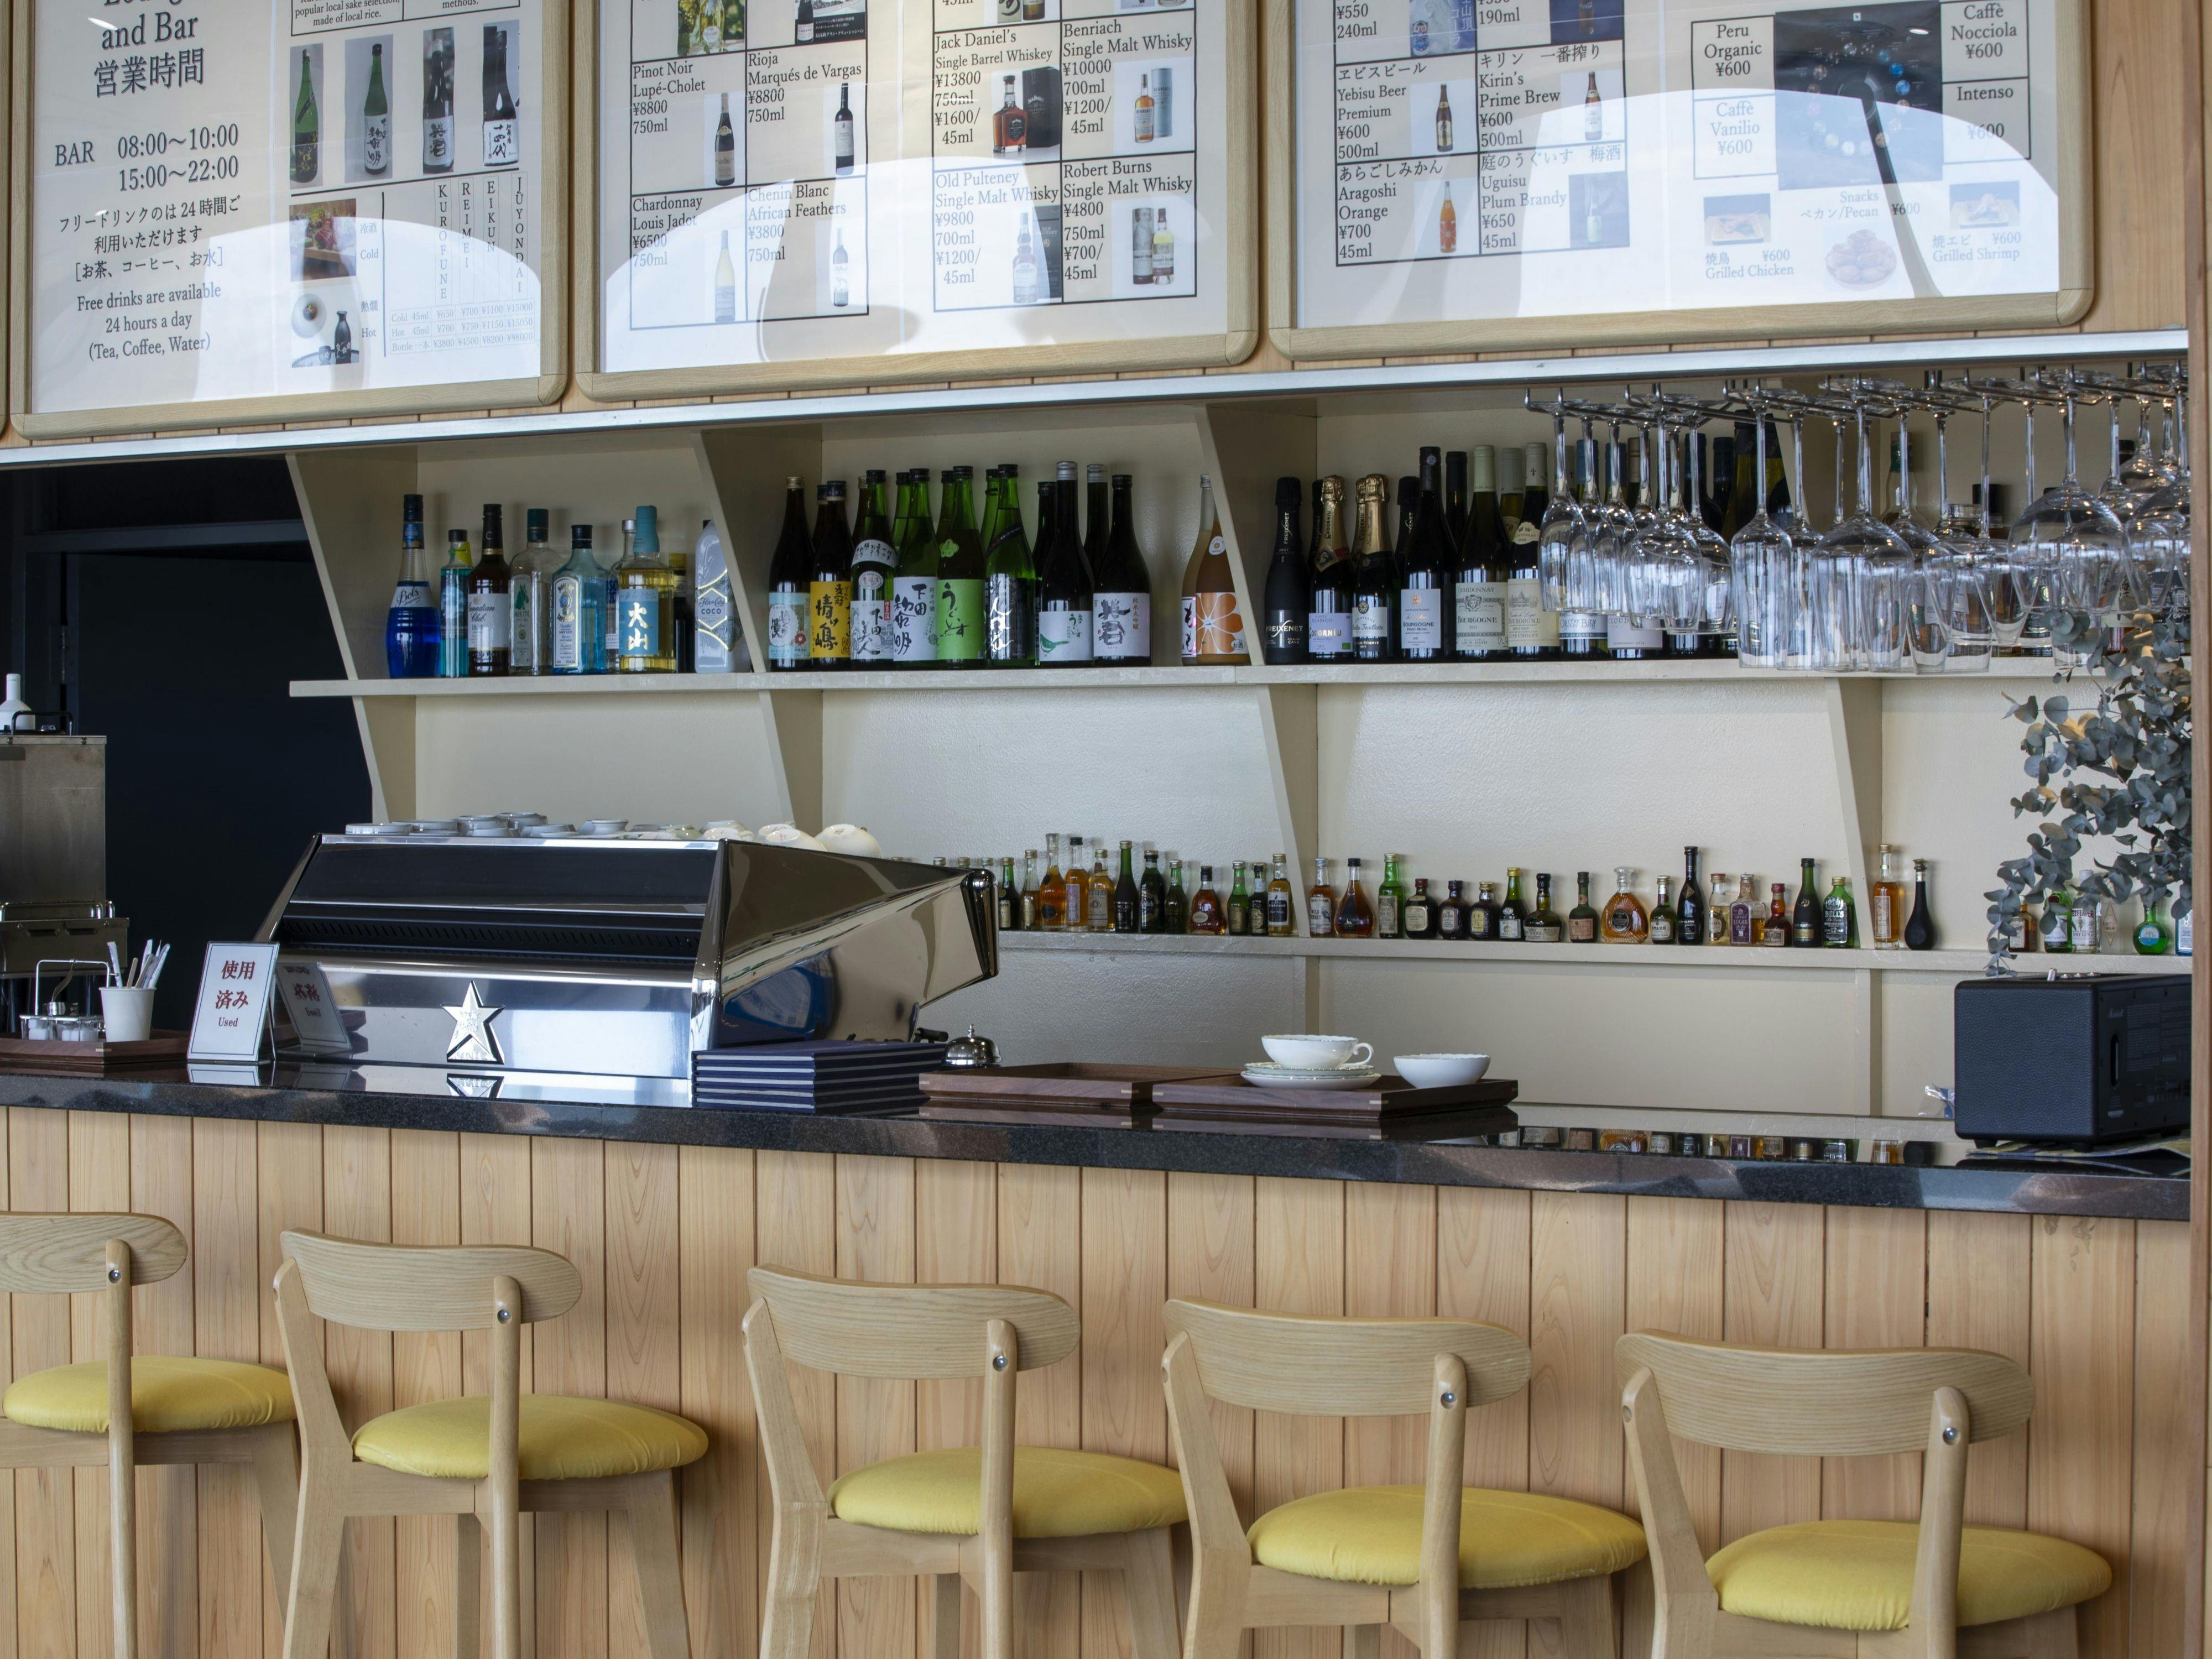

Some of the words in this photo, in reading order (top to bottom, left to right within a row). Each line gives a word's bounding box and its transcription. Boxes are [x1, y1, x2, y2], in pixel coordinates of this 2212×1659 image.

[295, 6, 324, 18] popular
[326, 2, 344, 12] local
[312, 15, 333, 26] made
[335, 13, 343, 23] of
[345, 11, 363, 22] local
[365, 10, 382, 19] rice.
[1336, 5, 1369, 19] ¥550
[1479, 8, 1520, 25] 190ml
[1963, 3, 2005, 20] Caffè
[102, 14, 146, 50] and
[155, 11, 199, 43] Bar
[1063, 20, 1122, 38] Benriach
[1337, 22, 1378, 38] 240ml
[1716, 24, 1749, 39] Peru
[1950, 23, 2017, 41] Nocciola
[935, 34, 961, 54] Jack
[1063, 40, 1103, 59] Single
[1107, 37, 1139, 54] Malt
[1141, 34, 1192, 52] Whisky
[1704, 42, 1762, 60] Organic
[1965, 43, 2003, 59] ¥600
[748, 53, 779, 67] Rioja
[936, 55, 968, 71] Single
[971, 51, 1003, 66] Barrel
[1007, 48, 1053, 65] Whiskey
[1480, 53, 1524, 69] キリン
[1540, 44, 1600, 64] 一番搾り
[93, 48, 205, 98] 営業時間
[633, 65, 664, 79] Pinot
[667, 62, 693, 76] Noir
[748, 67, 800, 87] Marqués
[804, 66, 818, 79] de
[821, 63, 862, 80] Vargas
[1063, 59, 1112, 76] ¥10000
[1715, 61, 1751, 76] ¥600
[935, 71, 981, 87] ¥13800
[1063, 79, 1105, 96] 700ml
[633, 78, 706, 98] Lupé-Cholet
[748, 88, 785, 104] ¥8800
[1337, 87, 1375, 103] Yebisu
[1378, 85, 1407, 98] Beer
[1957, 85, 2014, 101] Intenso
[1479, 92, 1521, 108] Prime
[1525, 89, 1561, 104] Brew
[633, 100, 667, 116] ¥8800
[1338, 106, 1391, 121] Premium
[1716, 101, 1755, 117] Caffè
[633, 118, 668, 134] 750ml
[1337, 124, 1370, 139] ¥600
[1709, 119, 1760, 137] Vanilio
[55, 141, 95, 167] BAR
[1338, 143, 1379, 159] 500ml
[1480, 149, 1573, 171] 庭のうぐいす
[1589, 145, 1621, 163] 梅酒
[1063, 163, 1108, 179] Robert
[1112, 160, 1152, 175] Burns
[1339, 158, 1443, 181] あらごしみかん
[936, 172, 961, 189] Old
[963, 171, 1019, 188] Pulteney
[1063, 182, 1104, 200] Single
[1108, 179, 1139, 195] Malt
[1142, 176, 1193, 194] Whisky
[1481, 175, 1527, 192] Uguisu
[748, 187, 792, 202] Chenin
[796, 185, 830, 199] Blanc
[1339, 182, 1396, 202] Aragoshi
[1481, 194, 1516, 210] Plum
[1519, 191, 1567, 208] Brandy
[1839, 189, 1880, 204] Snacks
[633, 196, 703, 213] Chardonnay
[748, 205, 792, 221] African
[795, 202, 846, 218] Feathers
[1063, 201, 1104, 218] ¥4800
[1339, 205, 1388, 221] Orange
[1891, 202, 1921, 216] ¥600
[461, 182, 472, 268] REIMEI
[486, 180, 496, 253] EIKUN
[633, 216, 664, 231] Louis
[667, 213, 697, 231] Jadot
[935, 211, 974, 227] ¥9800
[1481, 213, 1515, 229] ¥650
[359, 222, 378, 234] 冷酒
[515, 176, 524, 293] JUYONDAI
[748, 224, 784, 239] ¥3800
[1339, 223, 1371, 239] ¥700
[95, 225, 202, 254] 利用いただけます
[438, 184, 448, 300] KUROFUNE
[633, 233, 667, 249] ¥6500
[1932, 233, 1972, 249] 焼エビ
[360, 248, 379, 260] Cold
[1932, 247, 1973, 263] Grilled
[1976, 246, 2020, 262] Shrimp
[1065, 264, 1097, 280] 45ml
[1705, 263, 1745, 280] Grilled
[1747, 260, 1794, 277] Chicken
[77, 296, 103, 311] Free
[107, 290, 143, 309] drinks
[146, 292, 165, 304] are
[168, 283, 221, 302] available
[106, 317, 121, 333] 24
[123, 314, 158, 332] hours
[161, 316, 168, 328] a
[171, 311, 193, 330] day
[361, 327, 377, 338] Hot
[89, 342, 119, 362] (Tea,
[122, 338, 165, 358] Coffee,
[168, 332, 211, 352] Water)
[392, 342, 413, 352] Bottle
[433, 338, 455, 349] ¥3800
[457, 336, 479, 346] ¥4500
[482, 334, 504, 345] ¥8200
[221, 960, 255, 980] 使用
[215, 989, 249, 1009] 済み
[218, 1017, 238, 1027] Used
